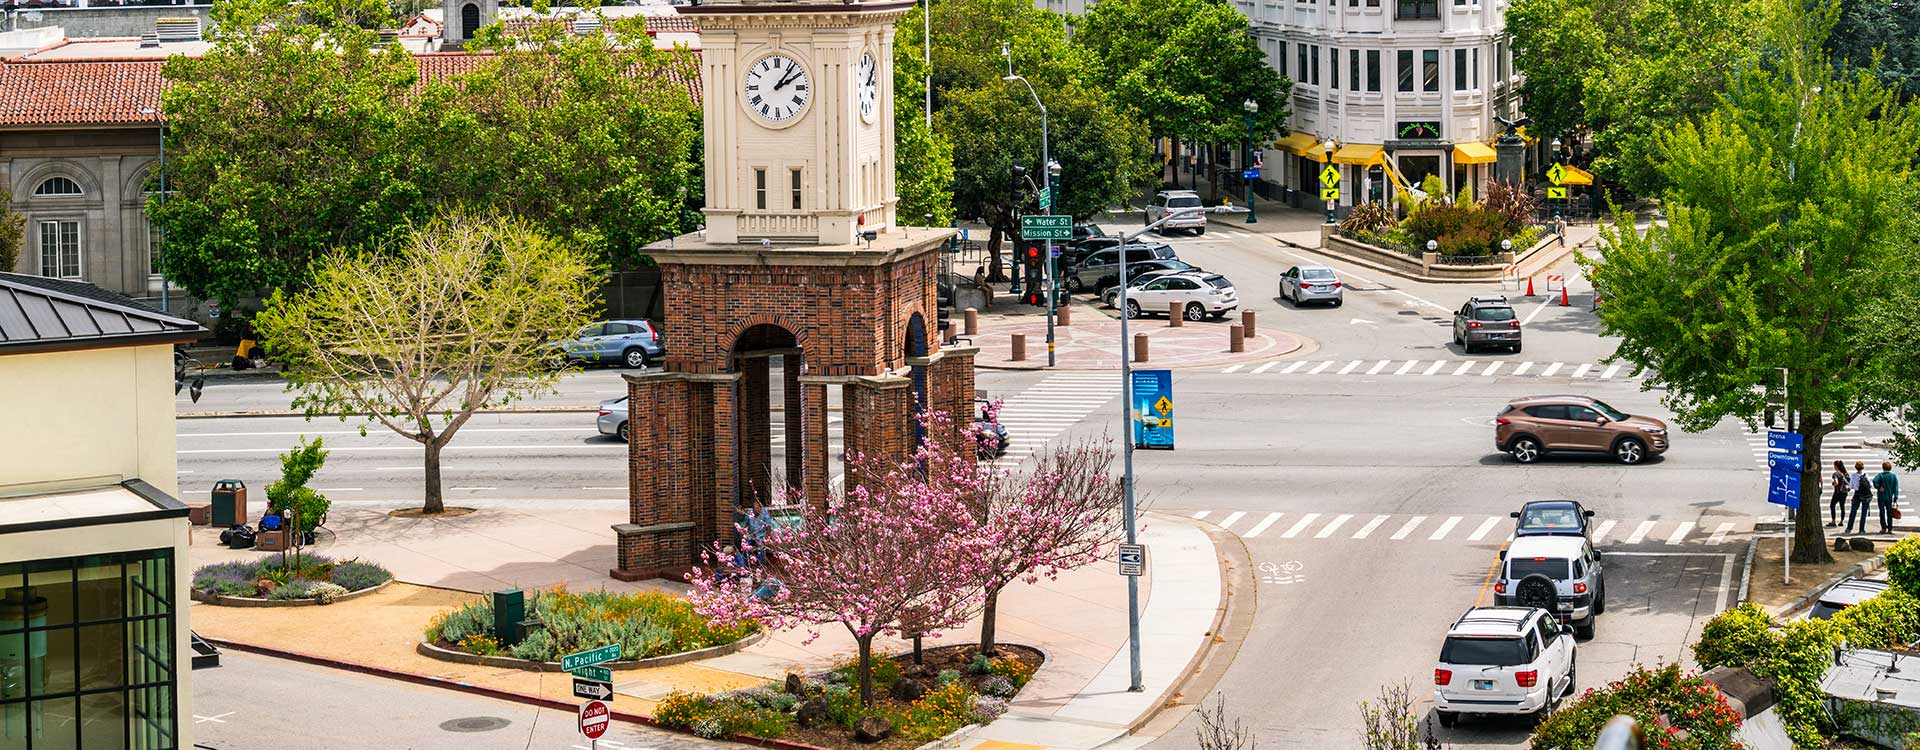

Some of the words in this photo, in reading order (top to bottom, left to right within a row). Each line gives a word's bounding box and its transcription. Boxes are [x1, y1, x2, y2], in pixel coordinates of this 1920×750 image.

[1035, 218, 1056, 226] Water
[1059, 218, 1068, 226] St
[1023, 229, 1052, 237] Mission
[1054, 229, 1063, 237] St
[1769, 432, 1786, 440] Arena
[1769, 452, 1799, 461] Downtown
[564, 659, 573, 668] N.
[574, 652, 602, 666] Pacific
[576, 684, 587, 693] ONE
[588, 686, 600, 695] WAY
[584, 709, 593, 718] DO
[594, 706, 605, 716] NOT
[586, 723, 605, 734] ENTER
